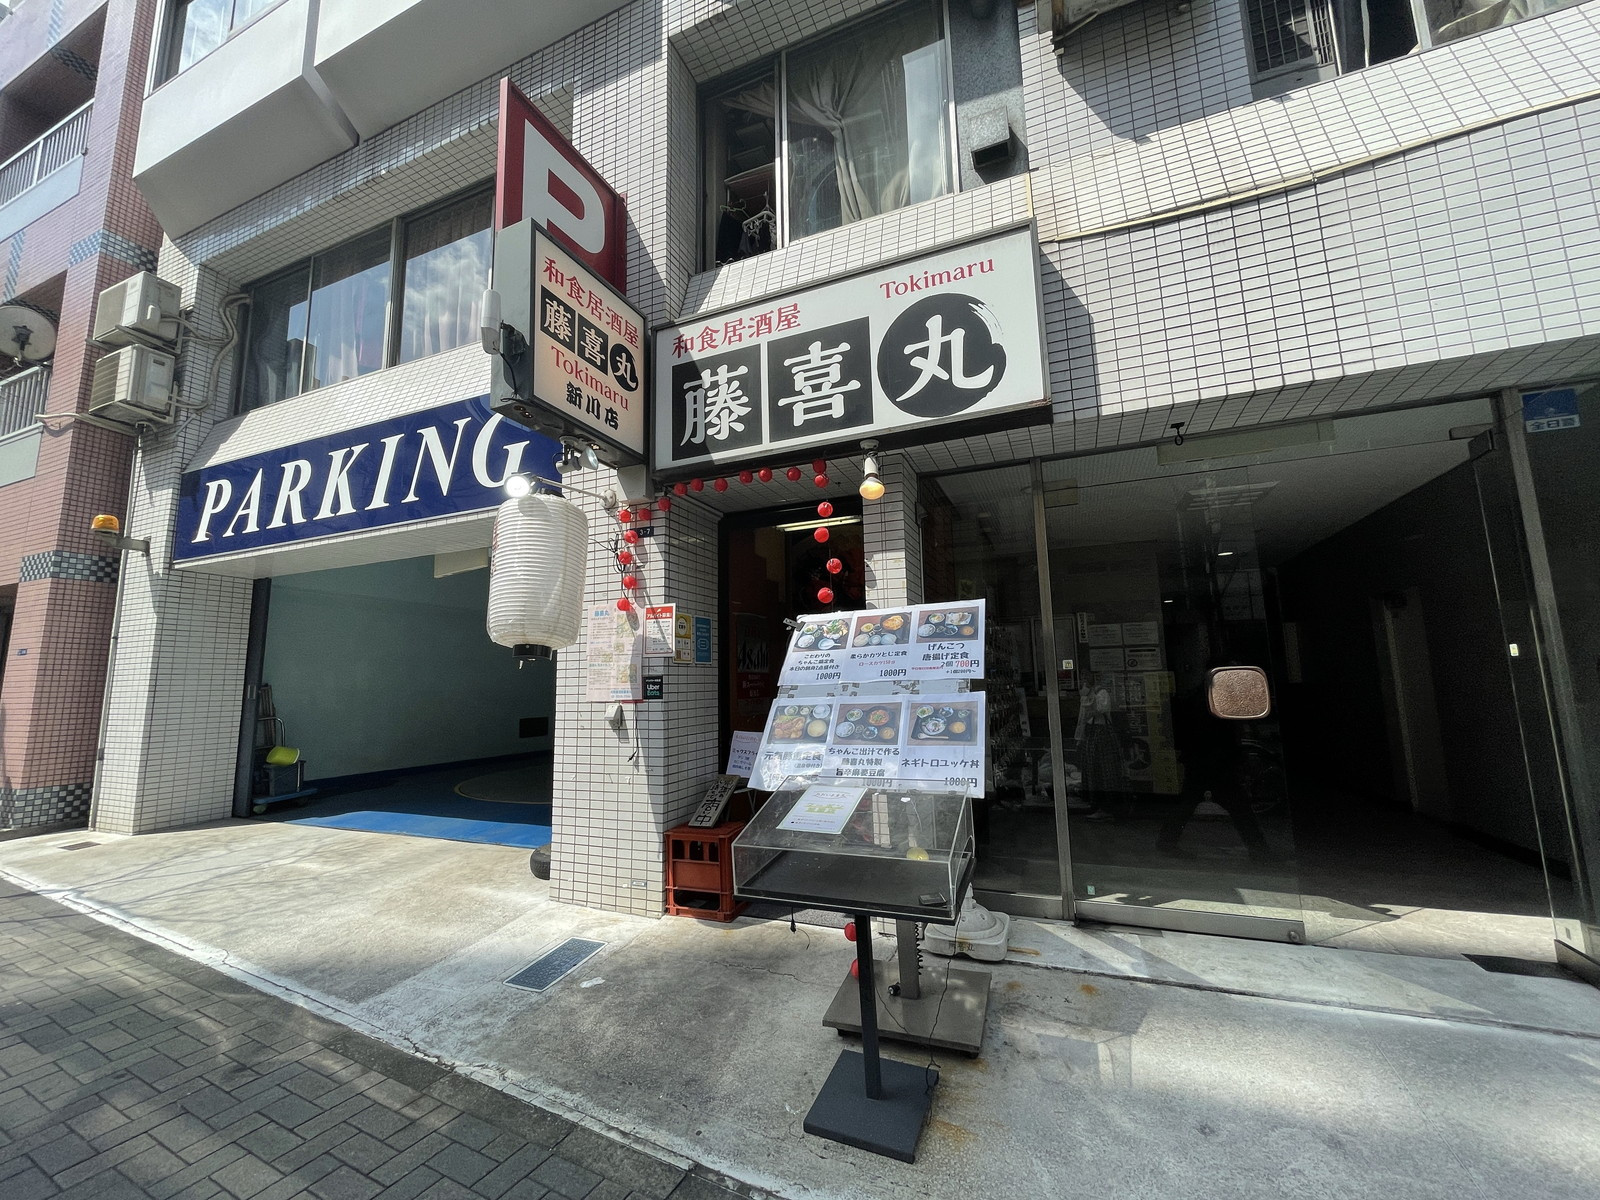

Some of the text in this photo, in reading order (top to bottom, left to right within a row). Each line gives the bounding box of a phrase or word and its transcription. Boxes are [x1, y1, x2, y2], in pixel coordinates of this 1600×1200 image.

[880, 256, 995, 300] Tokimaru
[543, 255, 639, 349] 和食居酒屋
[543, 298, 638, 389] 藤喜丸
[672, 302, 802, 359] 和食居酒屋
[551, 345, 629, 411] Tokimaru
[680, 313, 995, 448] 藤喜丸
[566, 381, 619, 430] 新川店
[191, 412, 530, 543] PARKING
[850, 650, 907, 659] 柔らかカツとじ定食
[922, 651, 970, 661] 唐揚げ定食
[928, 642, 965, 650] げんこつ
[816, 672, 841, 680] 1000円
[880, 668, 907, 677] 1000円
[955, 659, 980, 668] 700円
[828, 747, 900, 756] ちゃんこ出汁で作る
[901, 758, 980, 769] ネギトロユッケ丼
